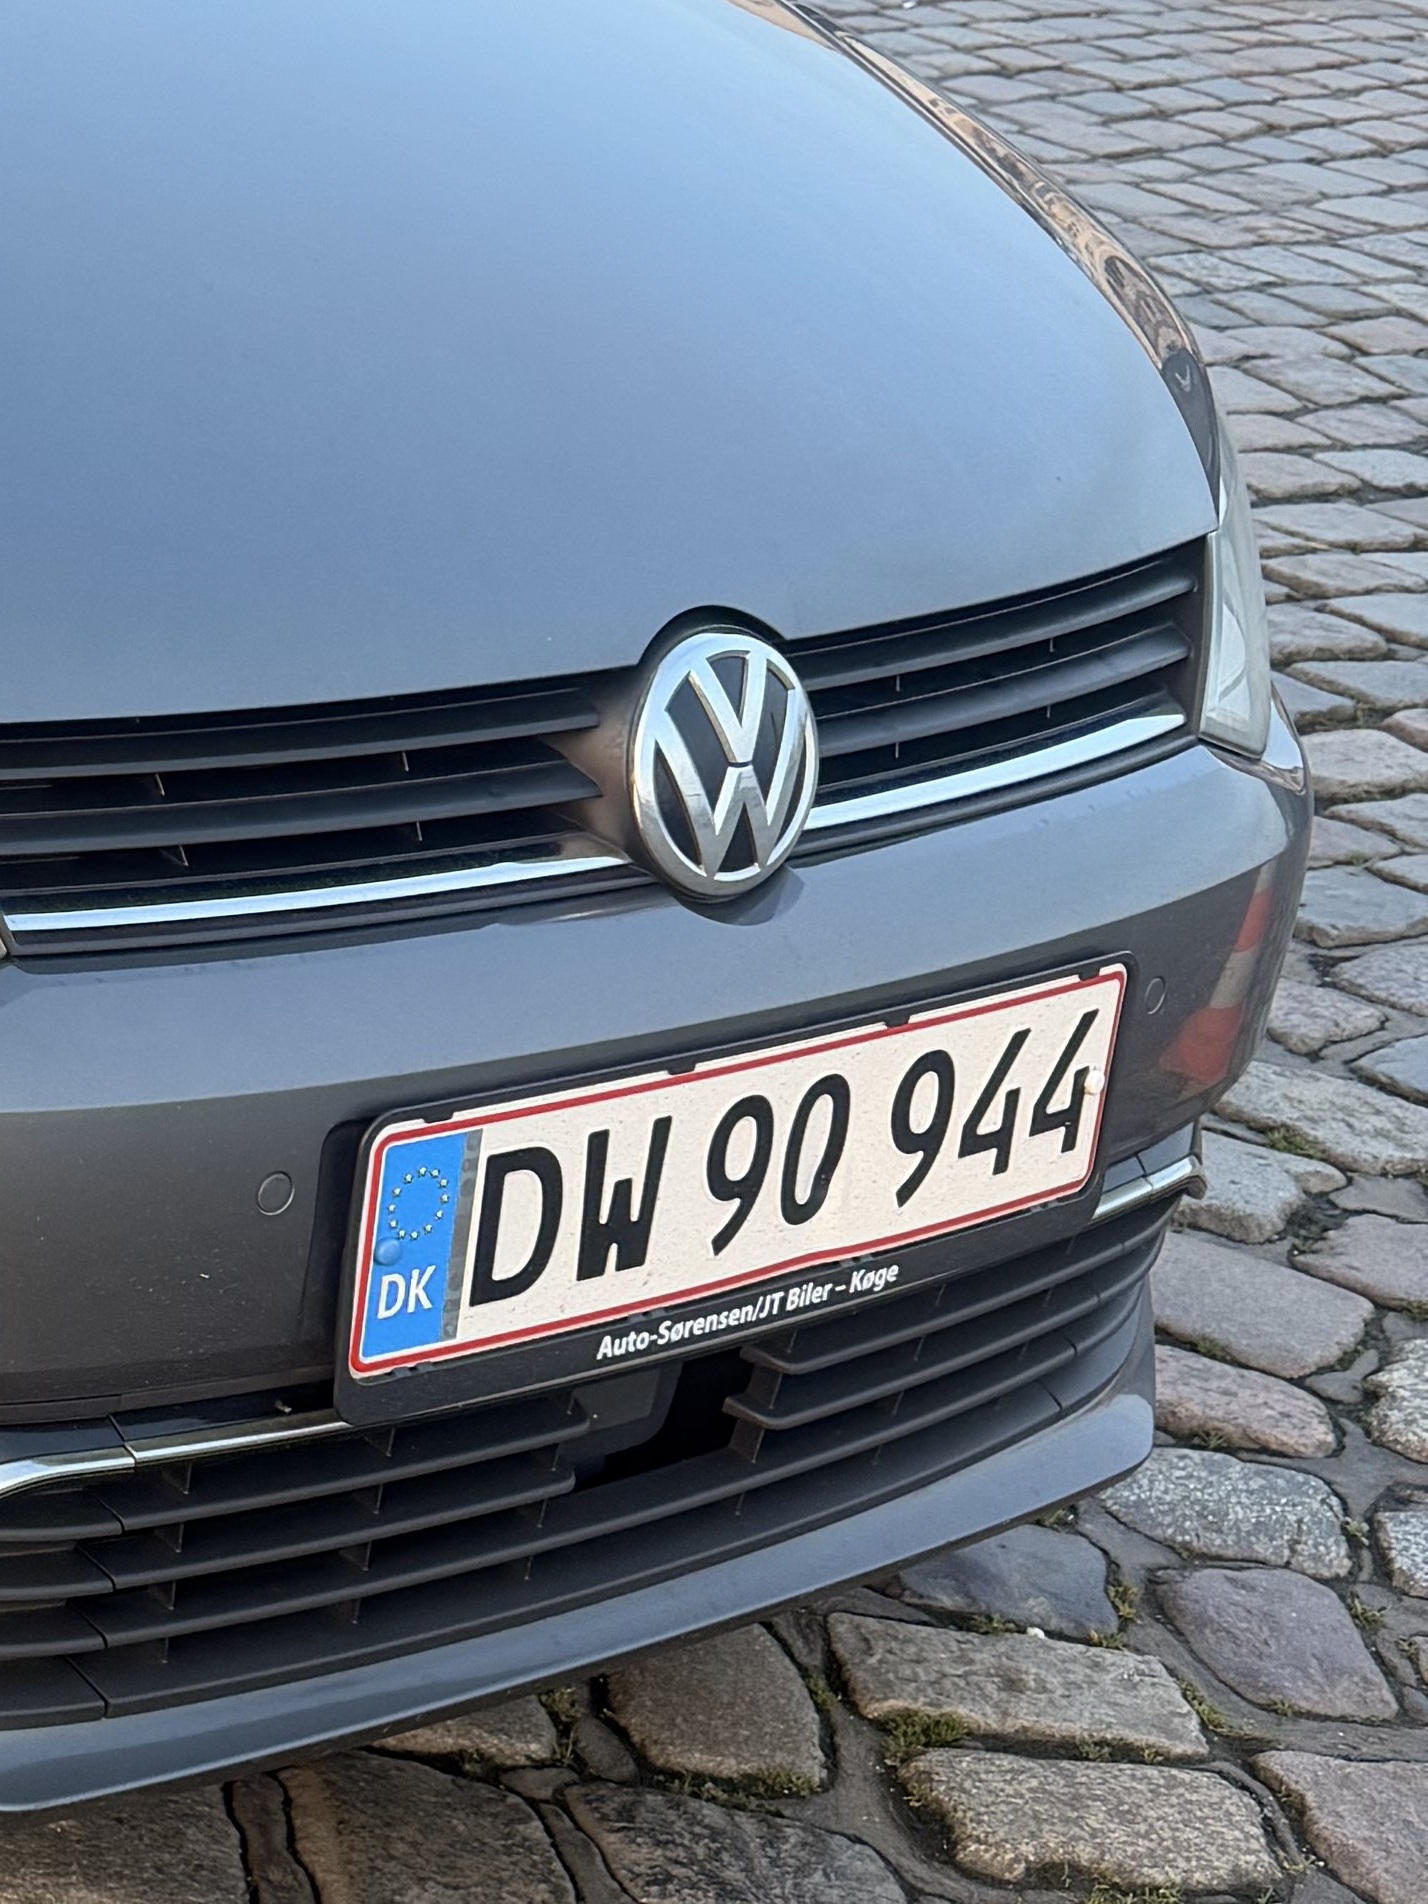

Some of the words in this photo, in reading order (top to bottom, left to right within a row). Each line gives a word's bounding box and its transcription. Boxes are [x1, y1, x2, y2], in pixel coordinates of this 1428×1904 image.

[469, 1115, 673, 1308] DW
[706, 1073, 851, 1257] 90
[890, 1007, 1100, 1208] 944
[376, 1265, 437, 1321] DK
[596, 1290, 785, 1360] Auto-Sørensen/JT
[785, 1283, 832, 1311] Biler
[849, 1264, 899, 1293] Køge
